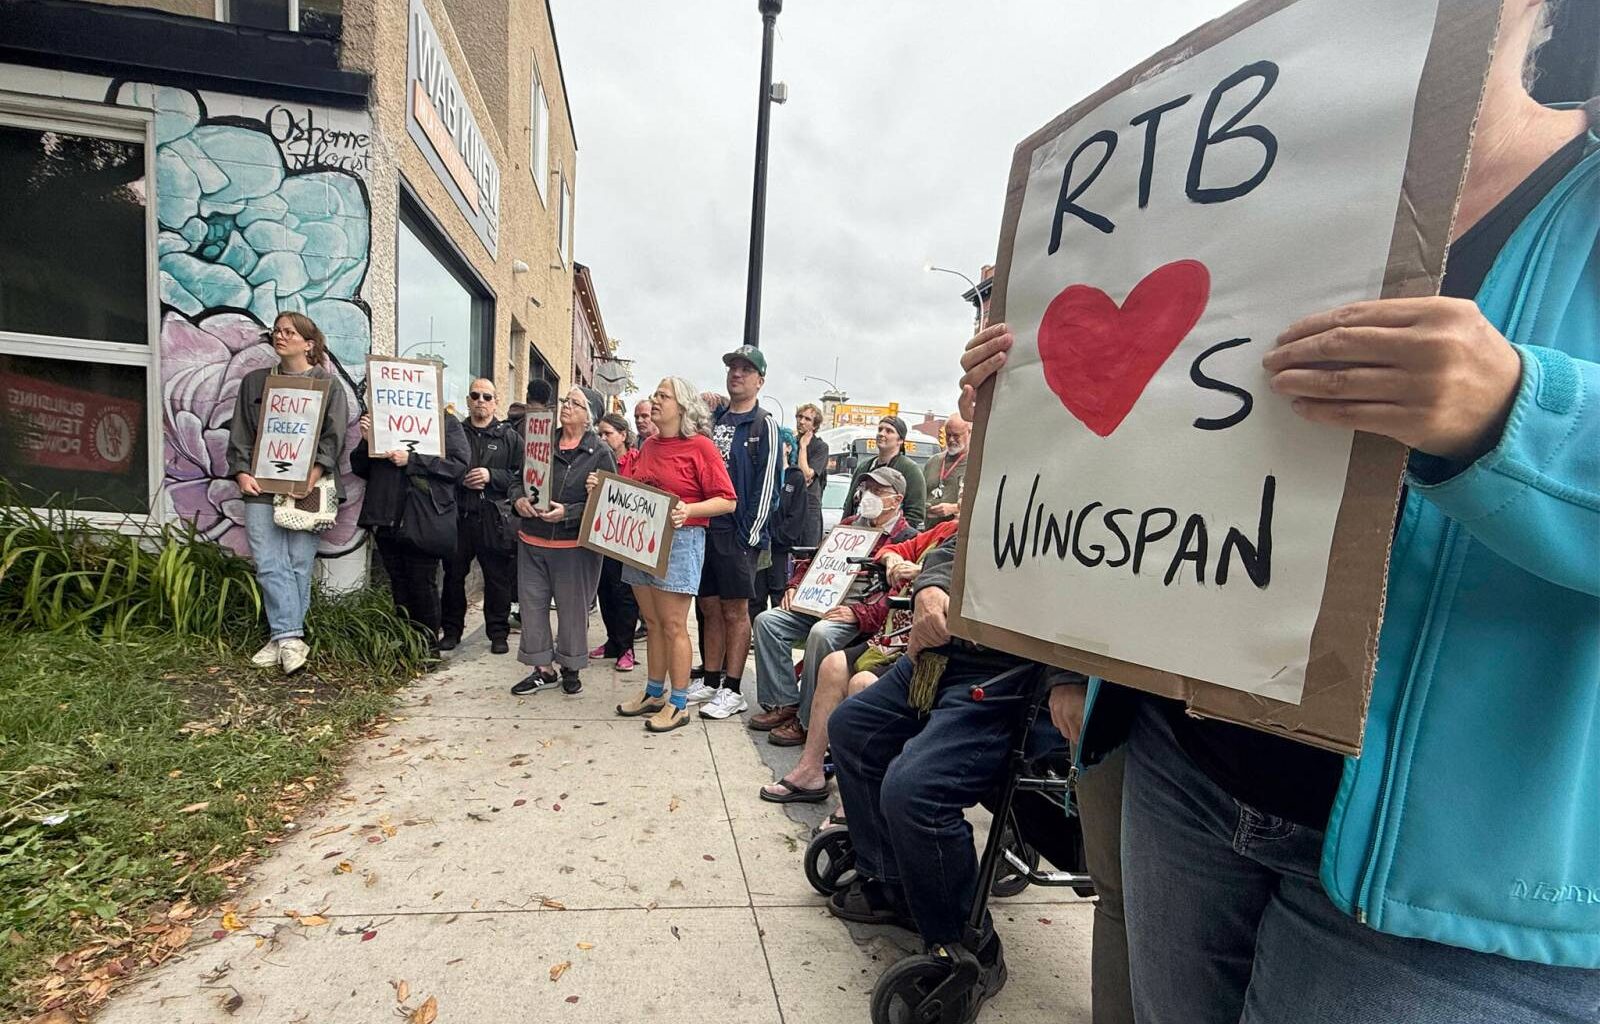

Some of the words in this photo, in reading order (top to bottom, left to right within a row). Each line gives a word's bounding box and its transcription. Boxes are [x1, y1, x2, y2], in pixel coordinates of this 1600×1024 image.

[416, 12, 457, 139] WAB
[460, 106, 499, 217] KINEW
[265, 105, 371, 150] Osborne
[1047, 60, 1280, 256] RTB
[381, 366, 425, 383] RENT
[1190, 338, 1254, 431] S
[270, 394, 313, 414] RENT
[376, 389, 433, 410] FREEZE
[267, 417, 310, 434] FREEZE
[388, 414, 433, 436] NOW
[528, 417, 551, 436] RENT
[267, 438, 305, 461] NOW
[526, 441, 550, 465] FREEZE
[525, 467, 546, 487] NOW
[607, 484, 657, 519] WINGSPAN
[992, 472, 1276, 590] WINGSPAN
[827, 531, 866, 554] STOP
[815, 572, 836, 586] OUR
[798, 586, 839, 607] HOMES
